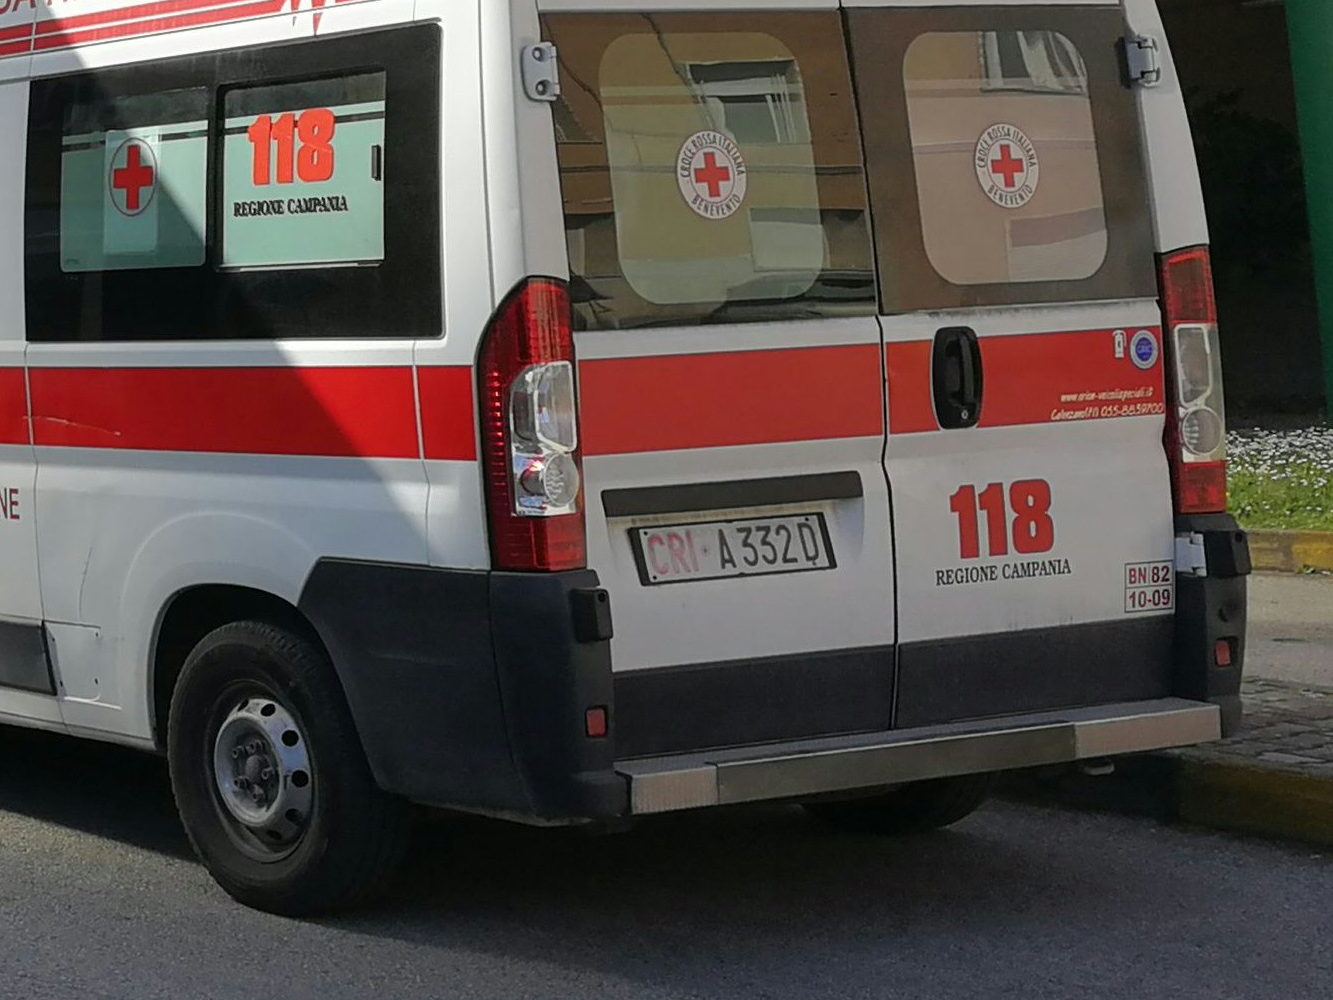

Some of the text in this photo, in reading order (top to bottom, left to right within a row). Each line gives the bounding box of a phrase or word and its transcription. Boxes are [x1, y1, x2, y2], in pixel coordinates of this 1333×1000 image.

[987, 126, 1011, 140] ROSSA
[247, 107, 335, 186] 118
[680, 146, 695, 178] CROCE
[692, 133, 717, 149] ROSSA
[233, 195, 349, 217] REGIONE CAMPANIA
[692, 194, 741, 216] BENEVENTO
[949, 478, 1055, 560] 118
[647, 522, 820, 575] CRI A332D
[935, 558, 1072, 586] REGIONE CAMPANIA
[1128, 565, 1171, 585] BN 82
[1128, 589, 1171, 609] 10-09
